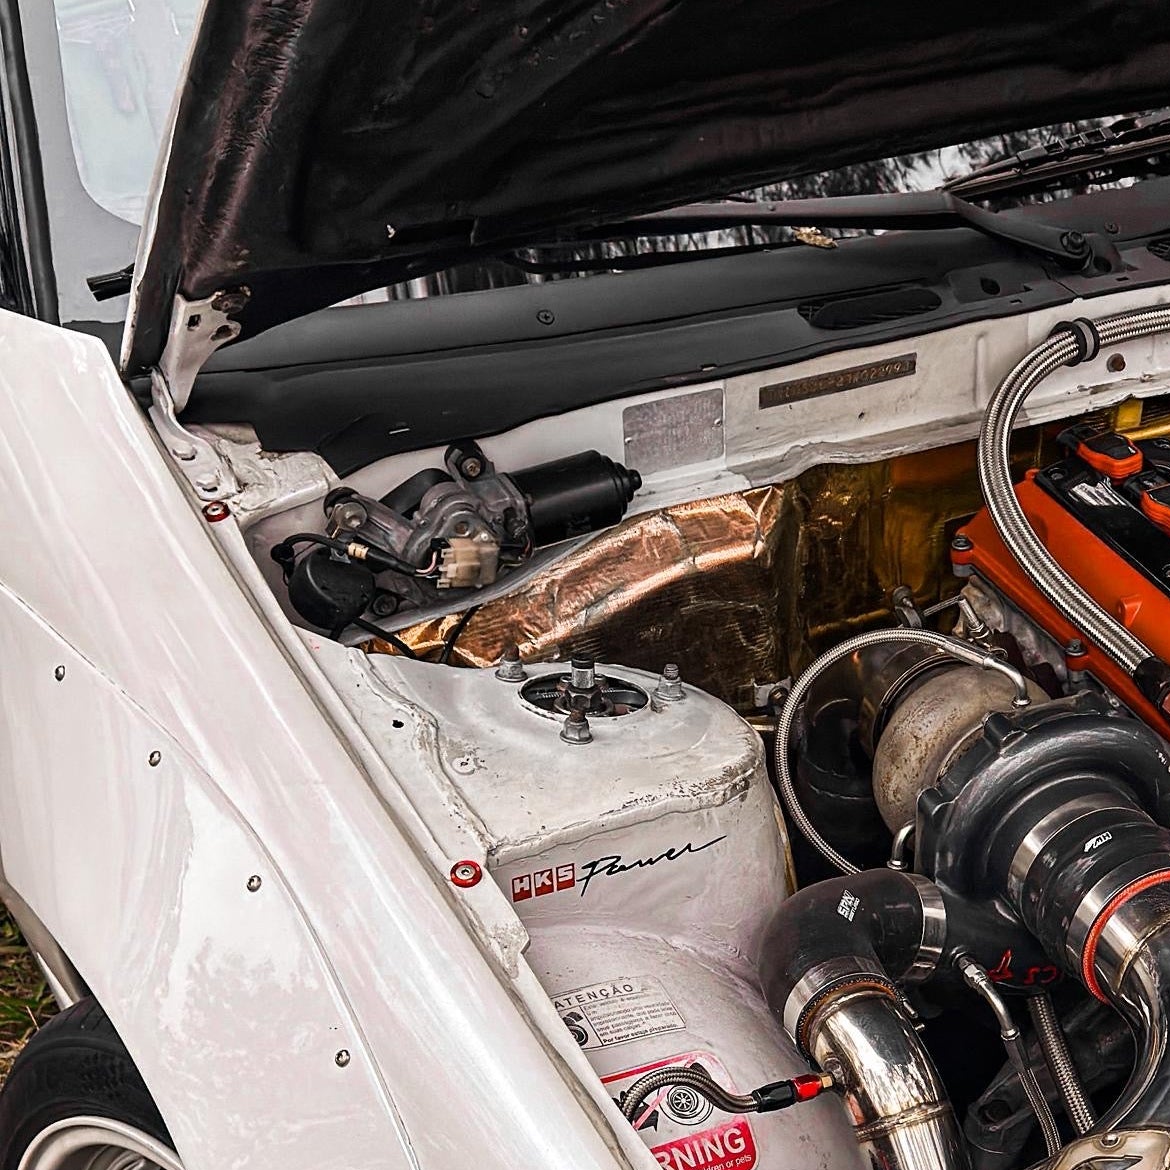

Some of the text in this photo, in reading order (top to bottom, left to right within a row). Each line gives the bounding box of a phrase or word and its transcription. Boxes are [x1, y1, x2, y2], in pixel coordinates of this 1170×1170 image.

[512, 835, 727, 902] HKS Power
[554, 982, 634, 1010] ATENÇÃO
[726, 1159, 735, 1168] or
[735, 1153, 752, 1168] pets
